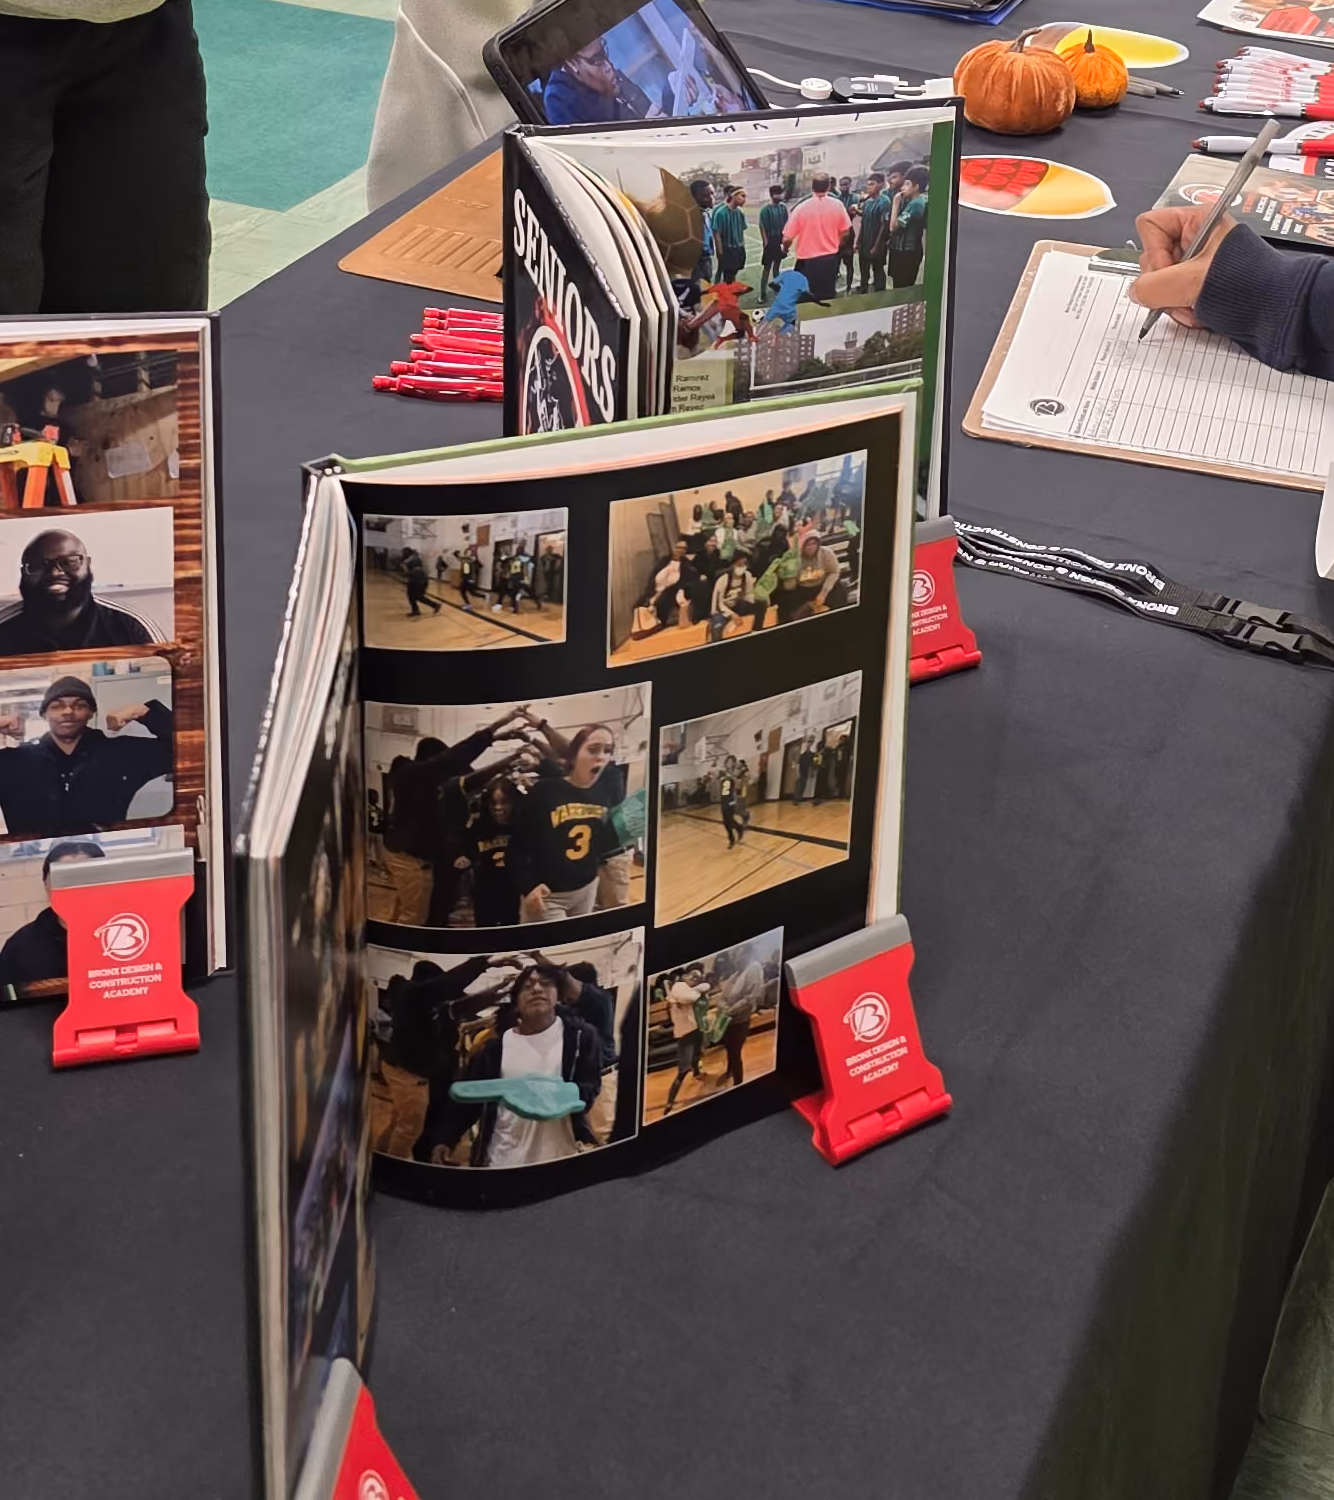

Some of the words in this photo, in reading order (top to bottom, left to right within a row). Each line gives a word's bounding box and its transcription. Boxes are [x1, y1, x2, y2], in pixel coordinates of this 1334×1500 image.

[513, 188, 617, 424] SENIORS
[673, 385, 701, 393] Ramos
[675, 374, 710, 383] Ramirez
[1068, 571, 1126, 597] DESIGN
[1114, 562, 1165, 591] BRONX
[1126, 596, 1180, 616] BRONX
[566, 824, 592, 860] 3
[88, 967, 120, 978] BRONX
[89, 973, 162, 990] CONSTRUCTION
[102, 986, 149, 999] ACADEMY
[849, 1046, 909, 1077] CONSTRUCTION
[862, 1061, 899, 1084] ACADEMY
